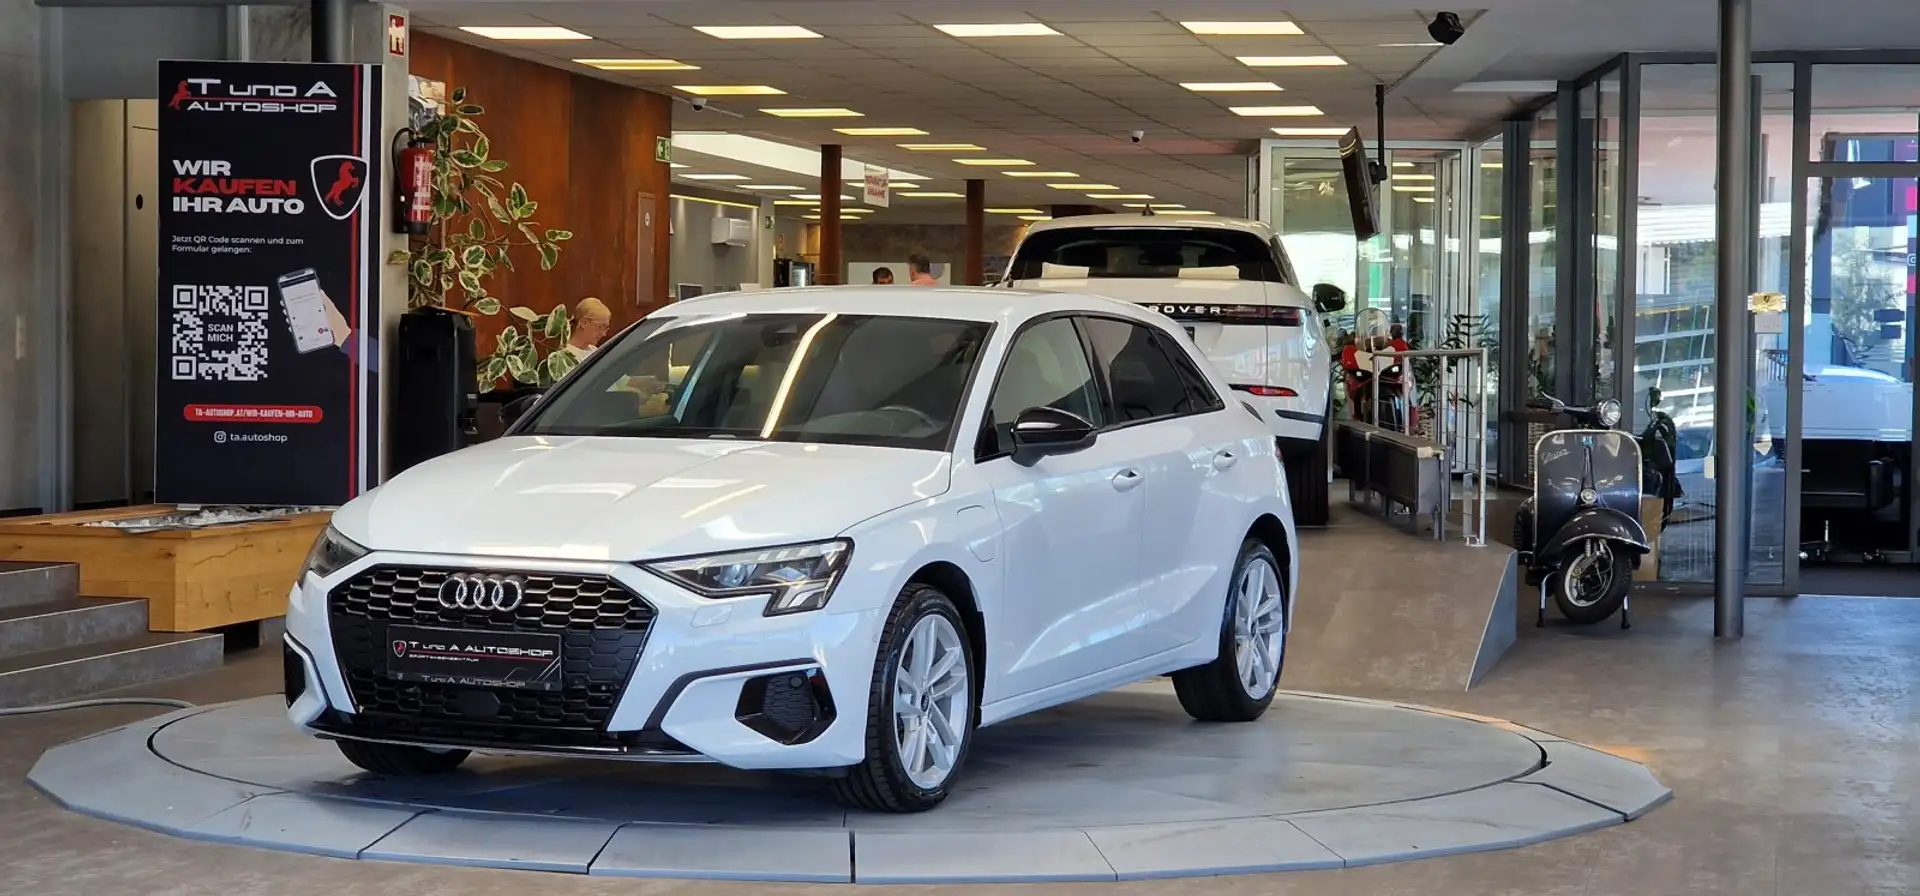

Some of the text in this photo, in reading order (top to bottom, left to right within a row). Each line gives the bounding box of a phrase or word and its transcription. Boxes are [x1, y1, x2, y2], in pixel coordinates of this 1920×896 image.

[187, 78, 221, 95] T
[304, 81, 337, 97] A
[187, 101, 337, 113] AUTOSHOP
[173, 160, 231, 176] WIR
[173, 178, 296, 196] KAUFEN
[173, 197, 305, 214] IHR AUTO
[172, 235, 192, 243] Jetzt
[193, 235, 207, 244] QR
[208, 236, 229, 244] Code
[267, 237, 284, 245] und
[172, 244, 252, 254] Formular gelangen:
[1148, 305, 1221, 315] ROVER
[207, 323, 234, 333] SCAN
[207, 333, 234, 342] MICH
[230, 432, 288, 443] ta.autoshop
[449, 644, 460, 652] A
[464, 645, 553, 657] AUTOSHOP
[460, 677, 526, 688] AUTOSHOP
